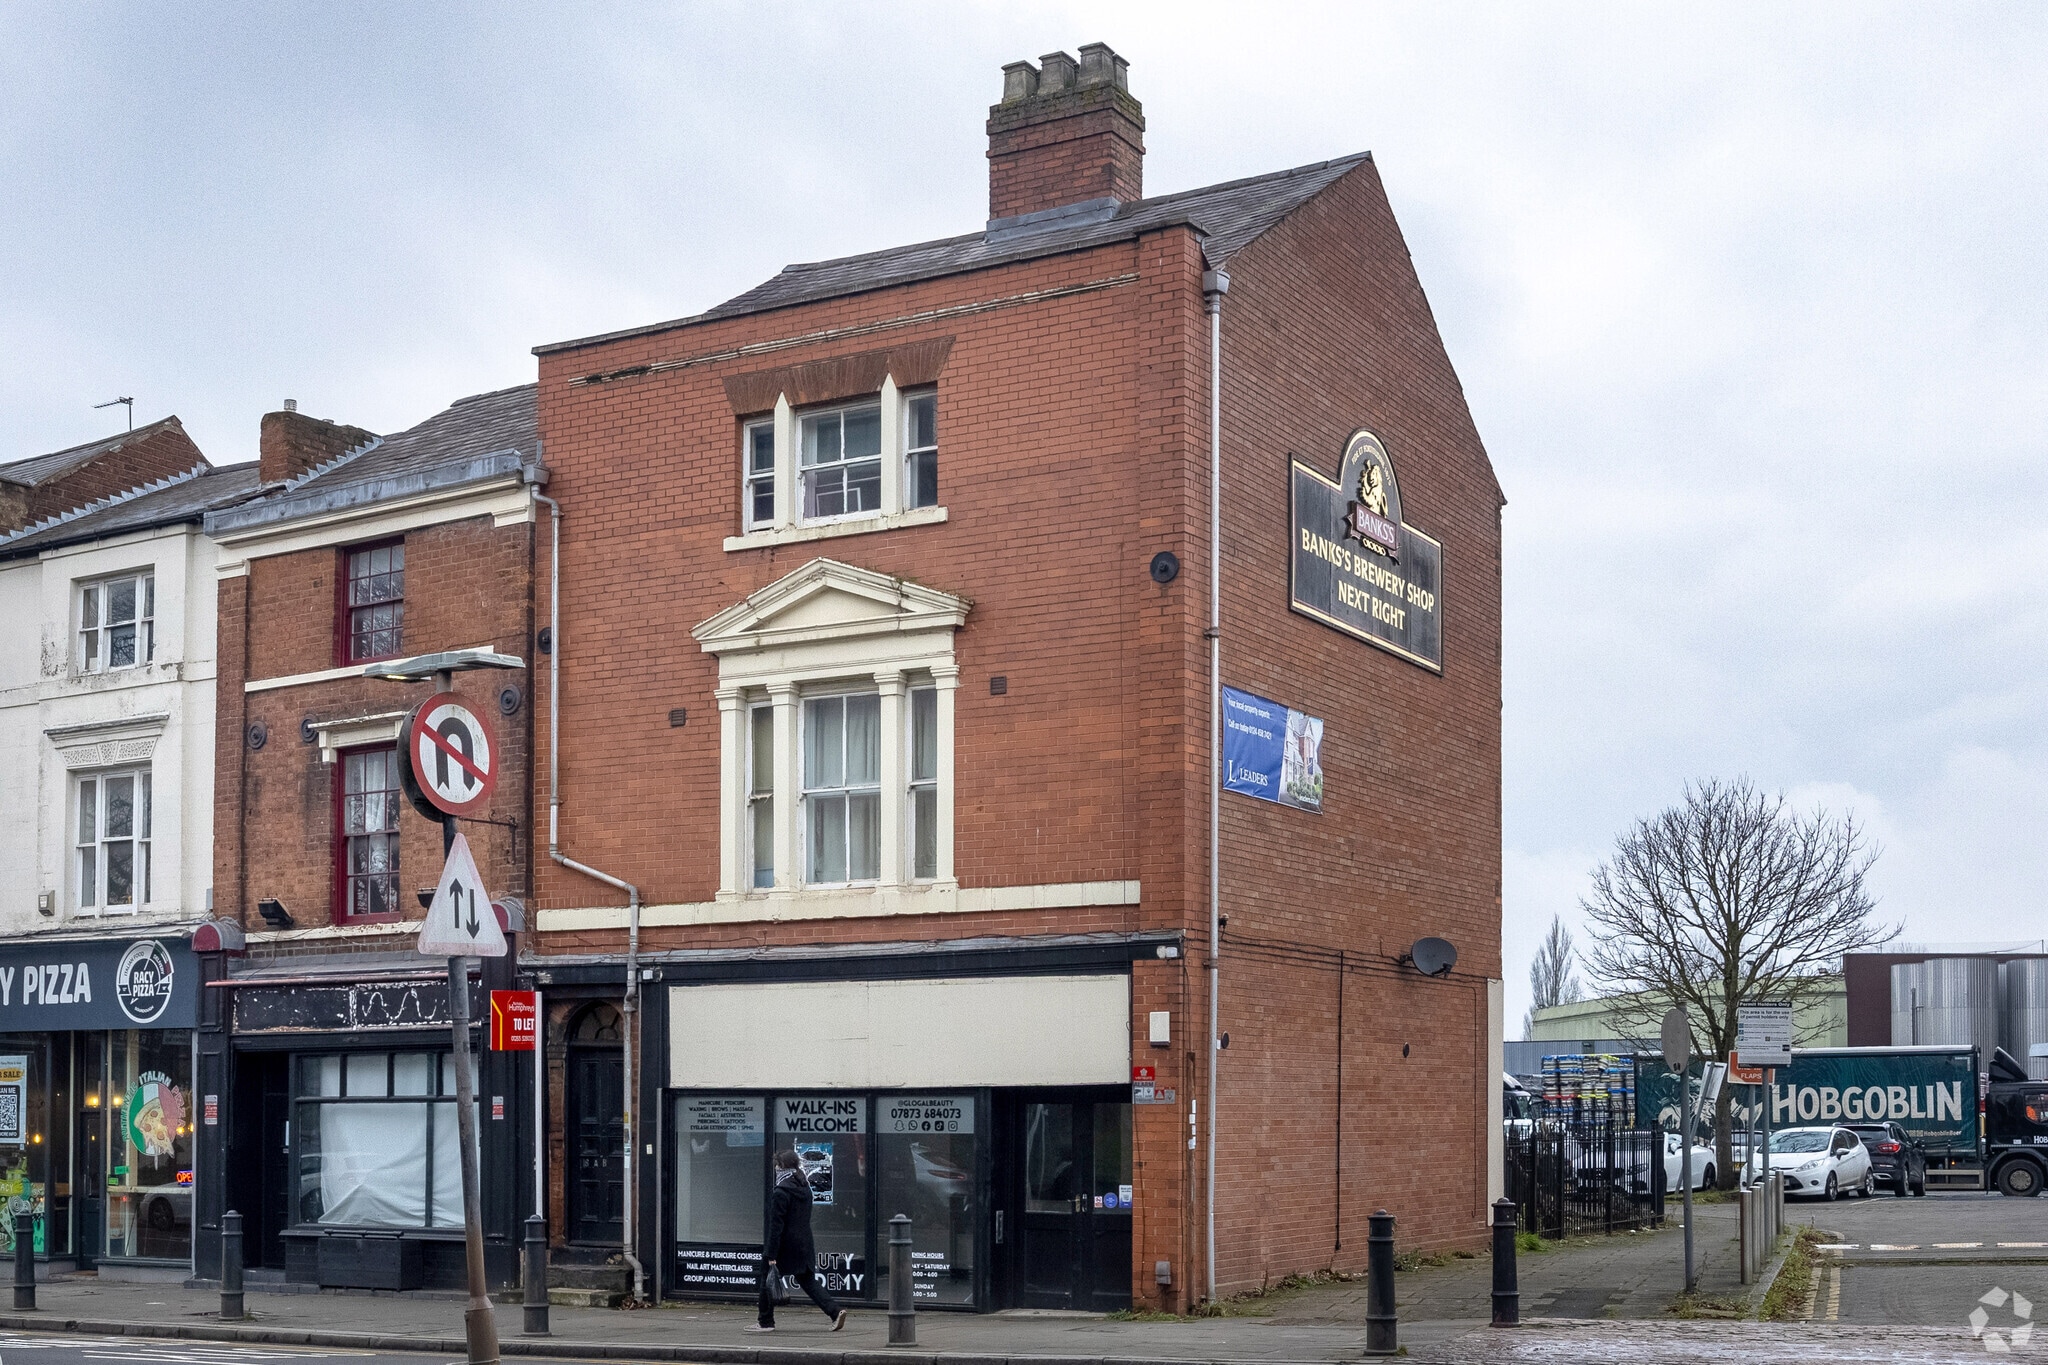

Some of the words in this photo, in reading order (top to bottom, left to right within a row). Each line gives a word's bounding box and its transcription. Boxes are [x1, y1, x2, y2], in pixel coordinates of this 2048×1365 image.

[1358, 508, 1394, 544] BANKS'S
[1302, 528, 1352, 572] BANKS'S
[1354, 554, 1405, 598] BREWERY
[1407, 582, 1434, 612] SHOP
[1338, 580, 1370, 613] NEXT
[1372, 596, 1405, 630] RIGHT
[1244, 704, 1258, 716] property
[1228, 760, 1236, 782] L
[1240, 768, 1268, 786] LEADERS
[124, 956, 133, 976] ITALIAN
[133, 951, 145, 960] FOOD
[23, 963, 92, 1005] PIZZA
[134, 971, 154, 984] RACY
[133, 984, 154, 997] PIZZA
[513, 1018, 522, 1030] TO
[523, 1018, 534, 1030] LET
[138, 1070, 172, 1087] ITALIAN
[786, 1101, 856, 1114] WALK-INS
[1772, 1081, 1962, 1122] HOBGOBLIN
[891, 1108, 921, 1118] 07873
[924, 1108, 961, 1118] 684073
[785, 1118, 857, 1132] WELCOME
[177, 1170, 192, 1183] OPE
[815, 1253, 854, 1270] UTY
